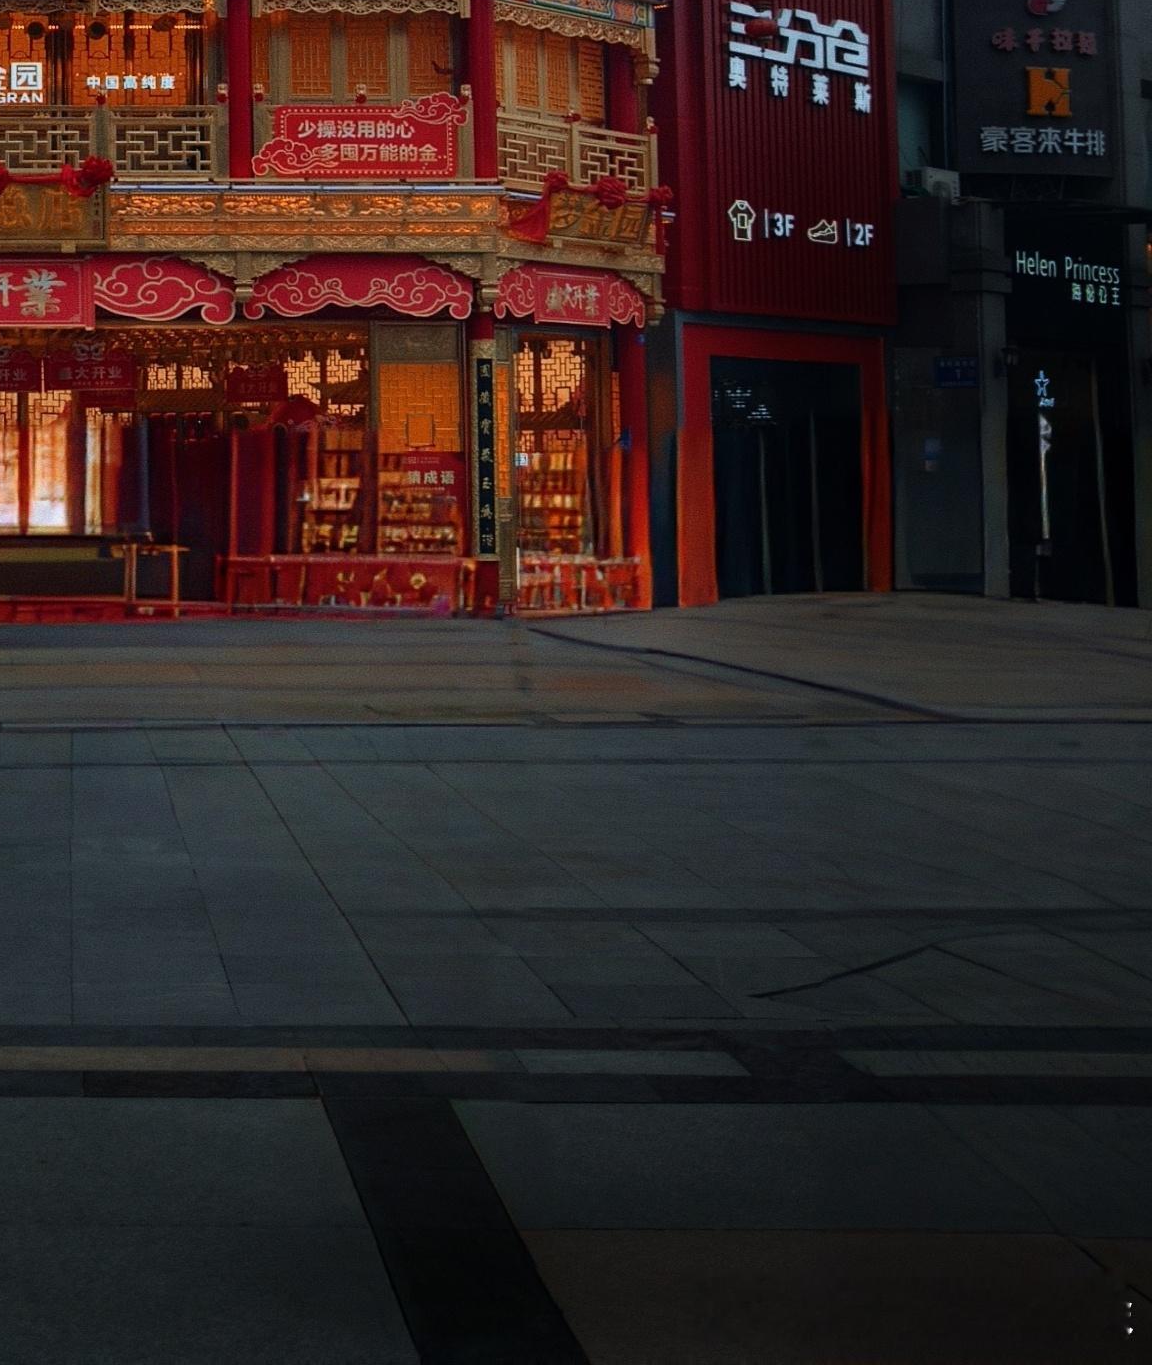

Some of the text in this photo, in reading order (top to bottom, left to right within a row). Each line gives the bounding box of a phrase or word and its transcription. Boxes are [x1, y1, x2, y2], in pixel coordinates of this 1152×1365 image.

[728, 55, 872, 115] 奥特莱斯
[297, 120, 416, 140] 少操没用的心
[320, 143, 439, 164] 多囤万能的金
[774, 216, 796, 239] 3F
[855, 222, 875, 247] 2F
[1014, 250, 1121, 284] Helen Princess
